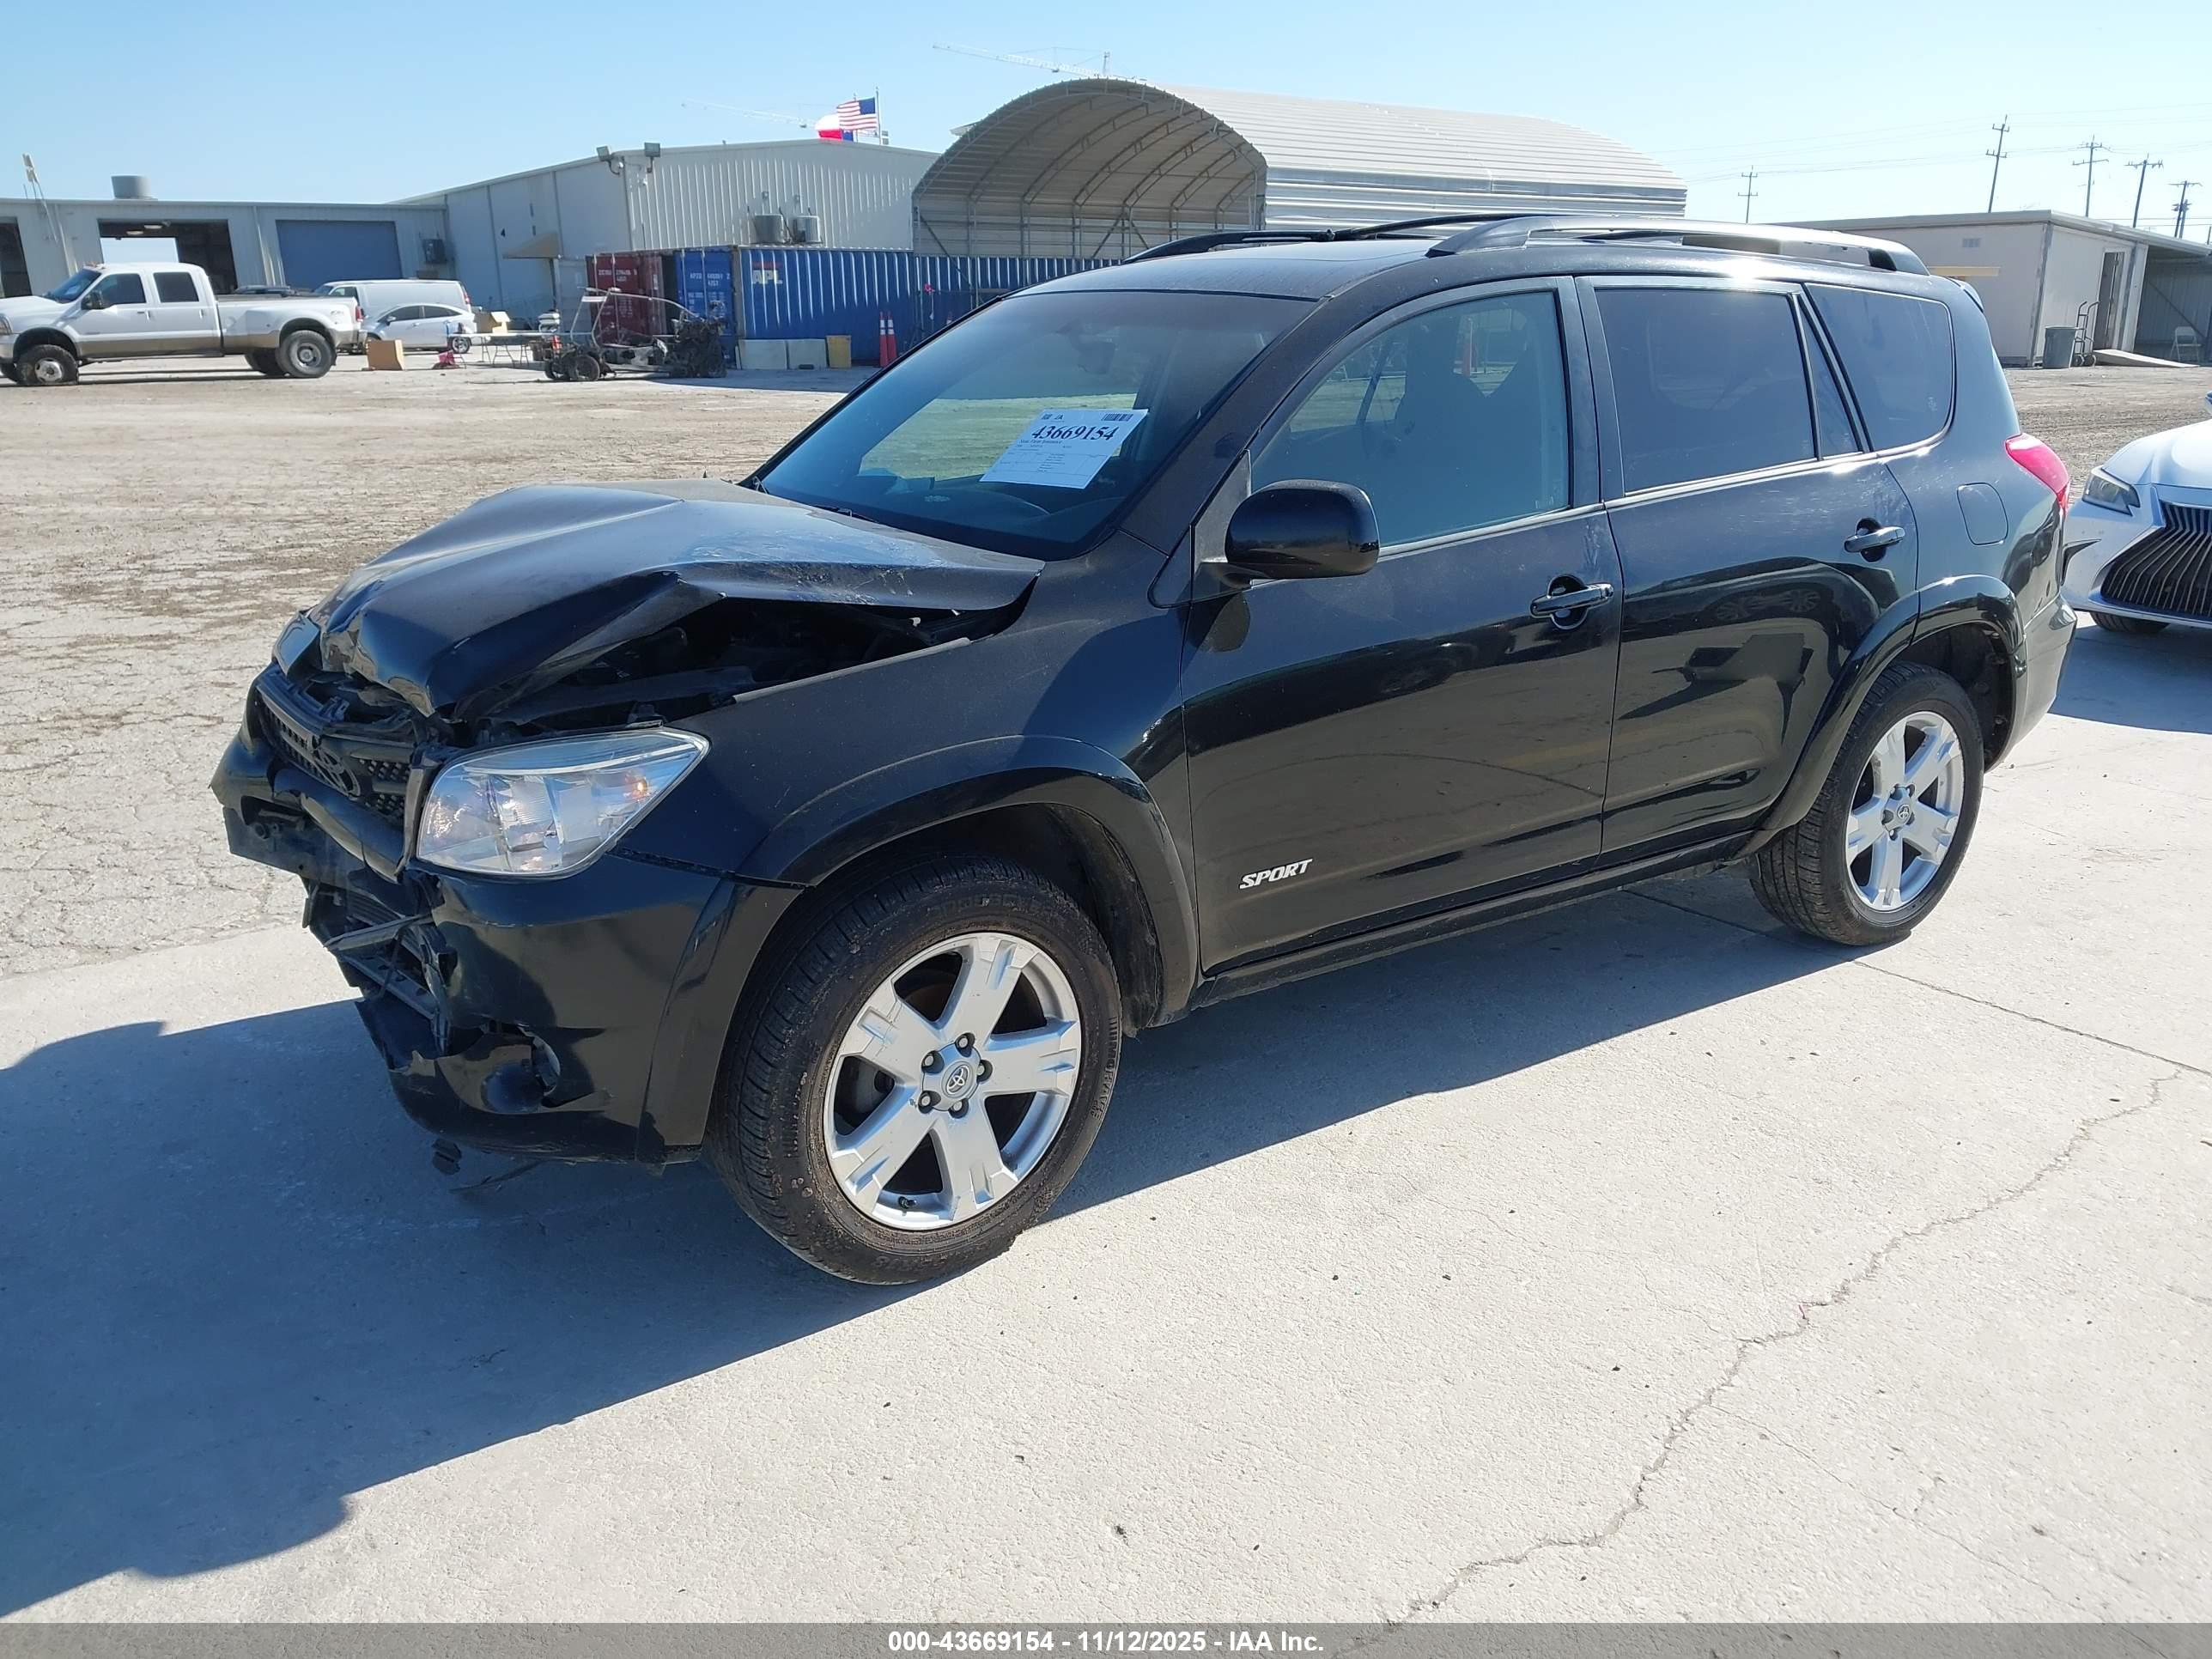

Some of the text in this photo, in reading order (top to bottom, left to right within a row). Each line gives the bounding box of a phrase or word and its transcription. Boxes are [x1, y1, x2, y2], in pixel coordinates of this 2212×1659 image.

[752, 270, 783, 284] APL
[1032, 425, 1120, 441] 43669154
[1239, 858, 1313, 890] SPORT
